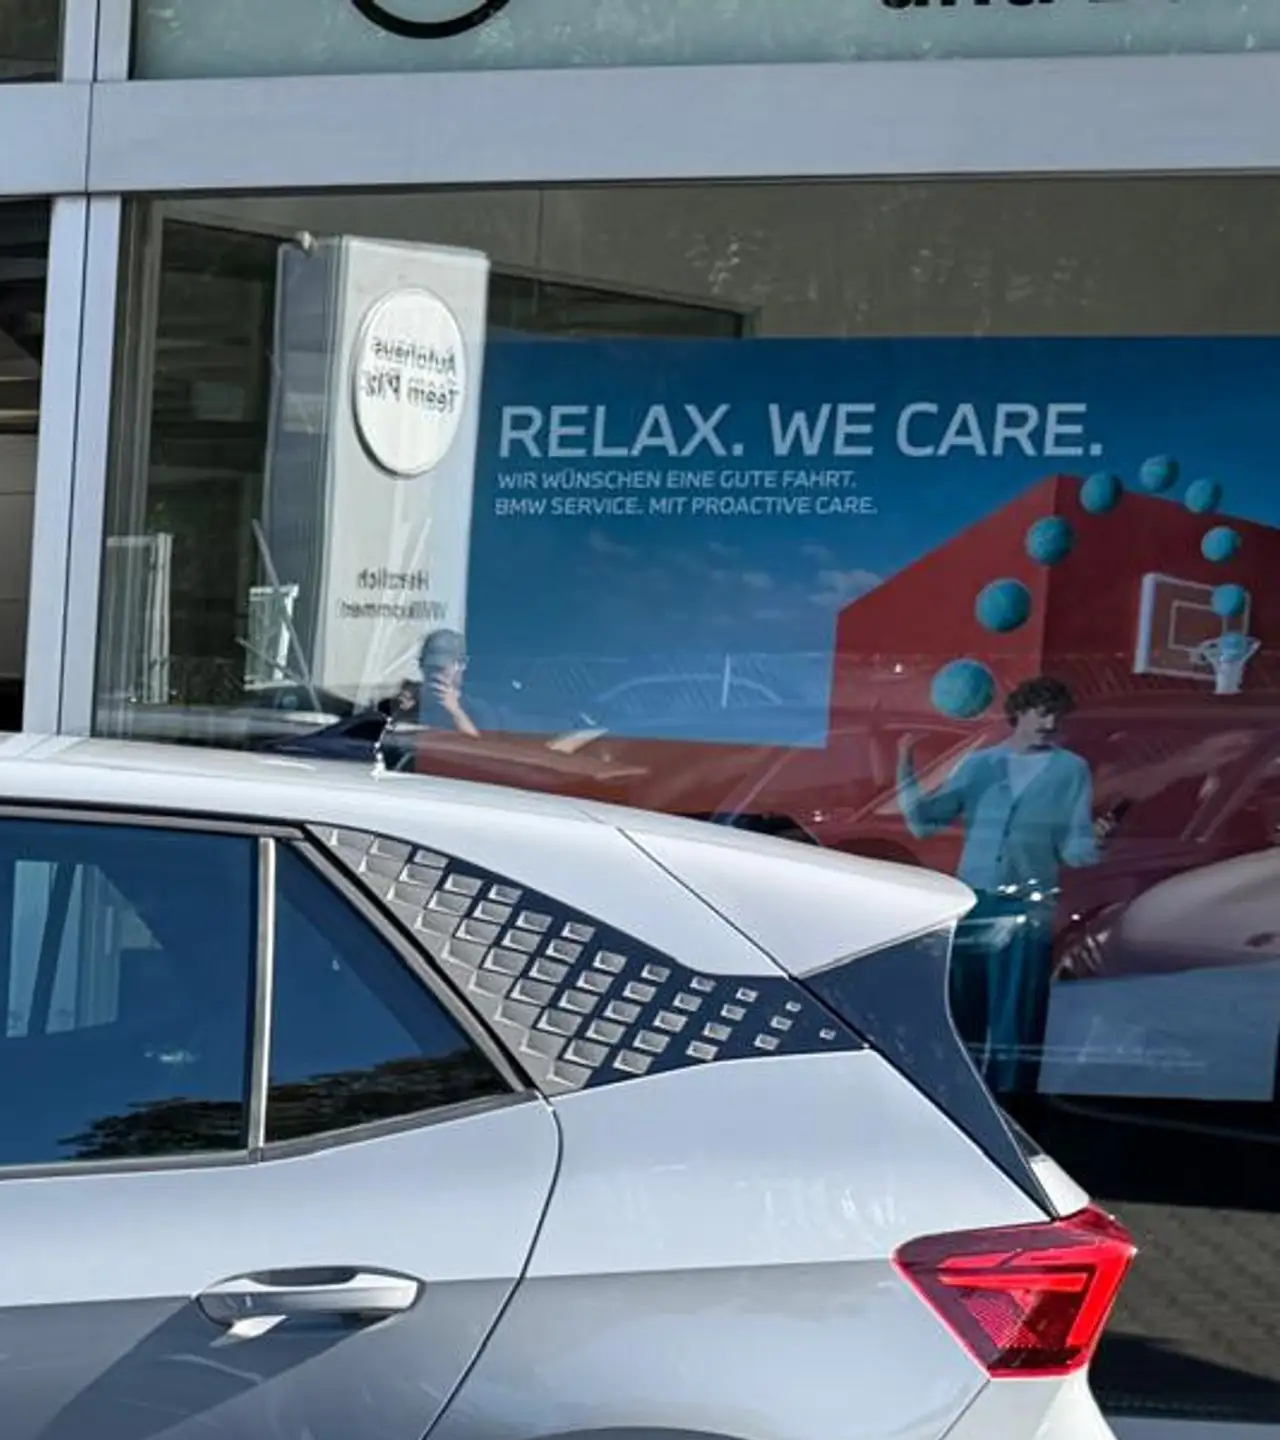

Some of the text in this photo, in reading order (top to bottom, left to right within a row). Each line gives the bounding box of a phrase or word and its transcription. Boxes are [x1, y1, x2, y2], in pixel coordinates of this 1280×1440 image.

[498, 401, 1104, 458] RELAX. WE CARE.
[497, 467, 858, 489] WIR WÜNSCHEN EINE GUTE FAHRT.
[494, 496, 879, 516] BMW SERVICE. MIT PROACTIVE CARE.
